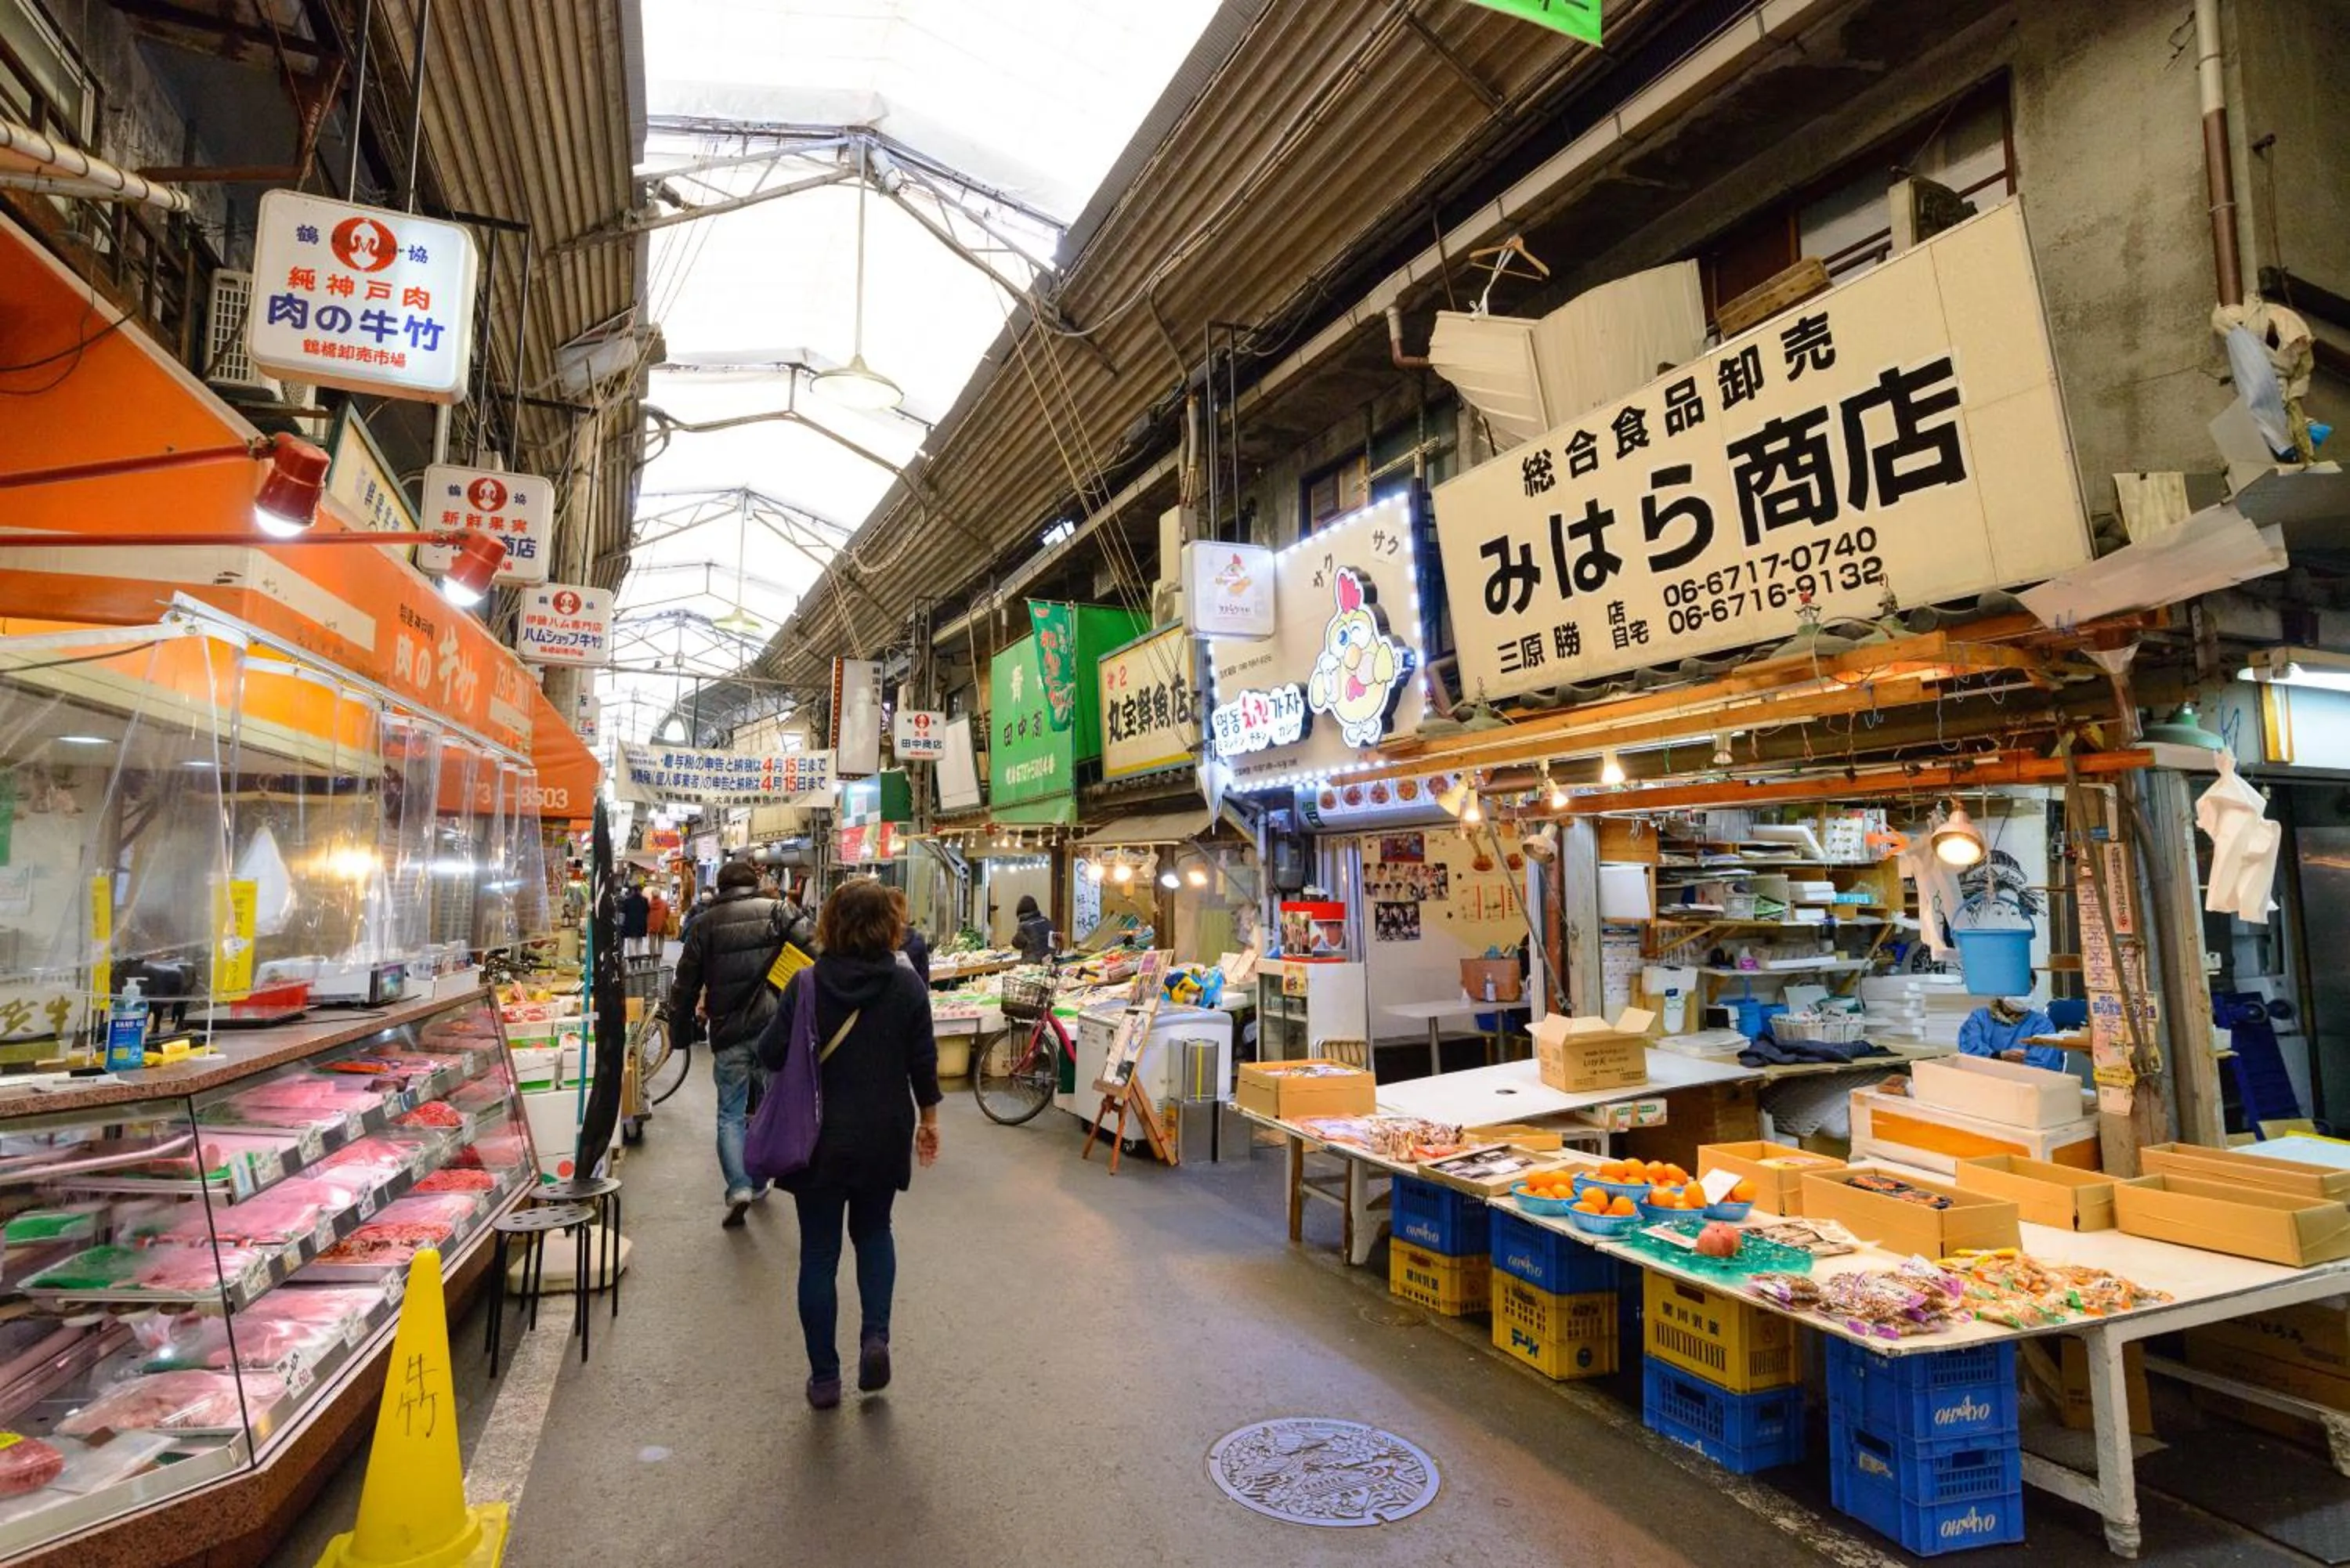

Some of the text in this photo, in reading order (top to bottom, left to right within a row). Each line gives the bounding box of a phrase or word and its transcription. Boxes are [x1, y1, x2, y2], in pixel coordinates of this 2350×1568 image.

[297, 224, 428, 263] 鶴 協
[288, 266, 430, 310] 純神戸肉
[268, 293, 444, 351] 肉の牛竹
[303, 338, 406, 368] 鶴橋卸売市場
[1522, 311, 1837, 497] 総合食品卸売
[1480, 356, 1968, 615] みはら商店
[442, 511, 527, 533] 新鮮果実
[1607, 526, 1877, 624] 店 06-6717-0740
[1612, 557, 1883, 651] 自宅 06-6716-9132
[1497, 623, 1582, 674] 三原 勝
[396, 1353, 439, 1438] 牛竹
